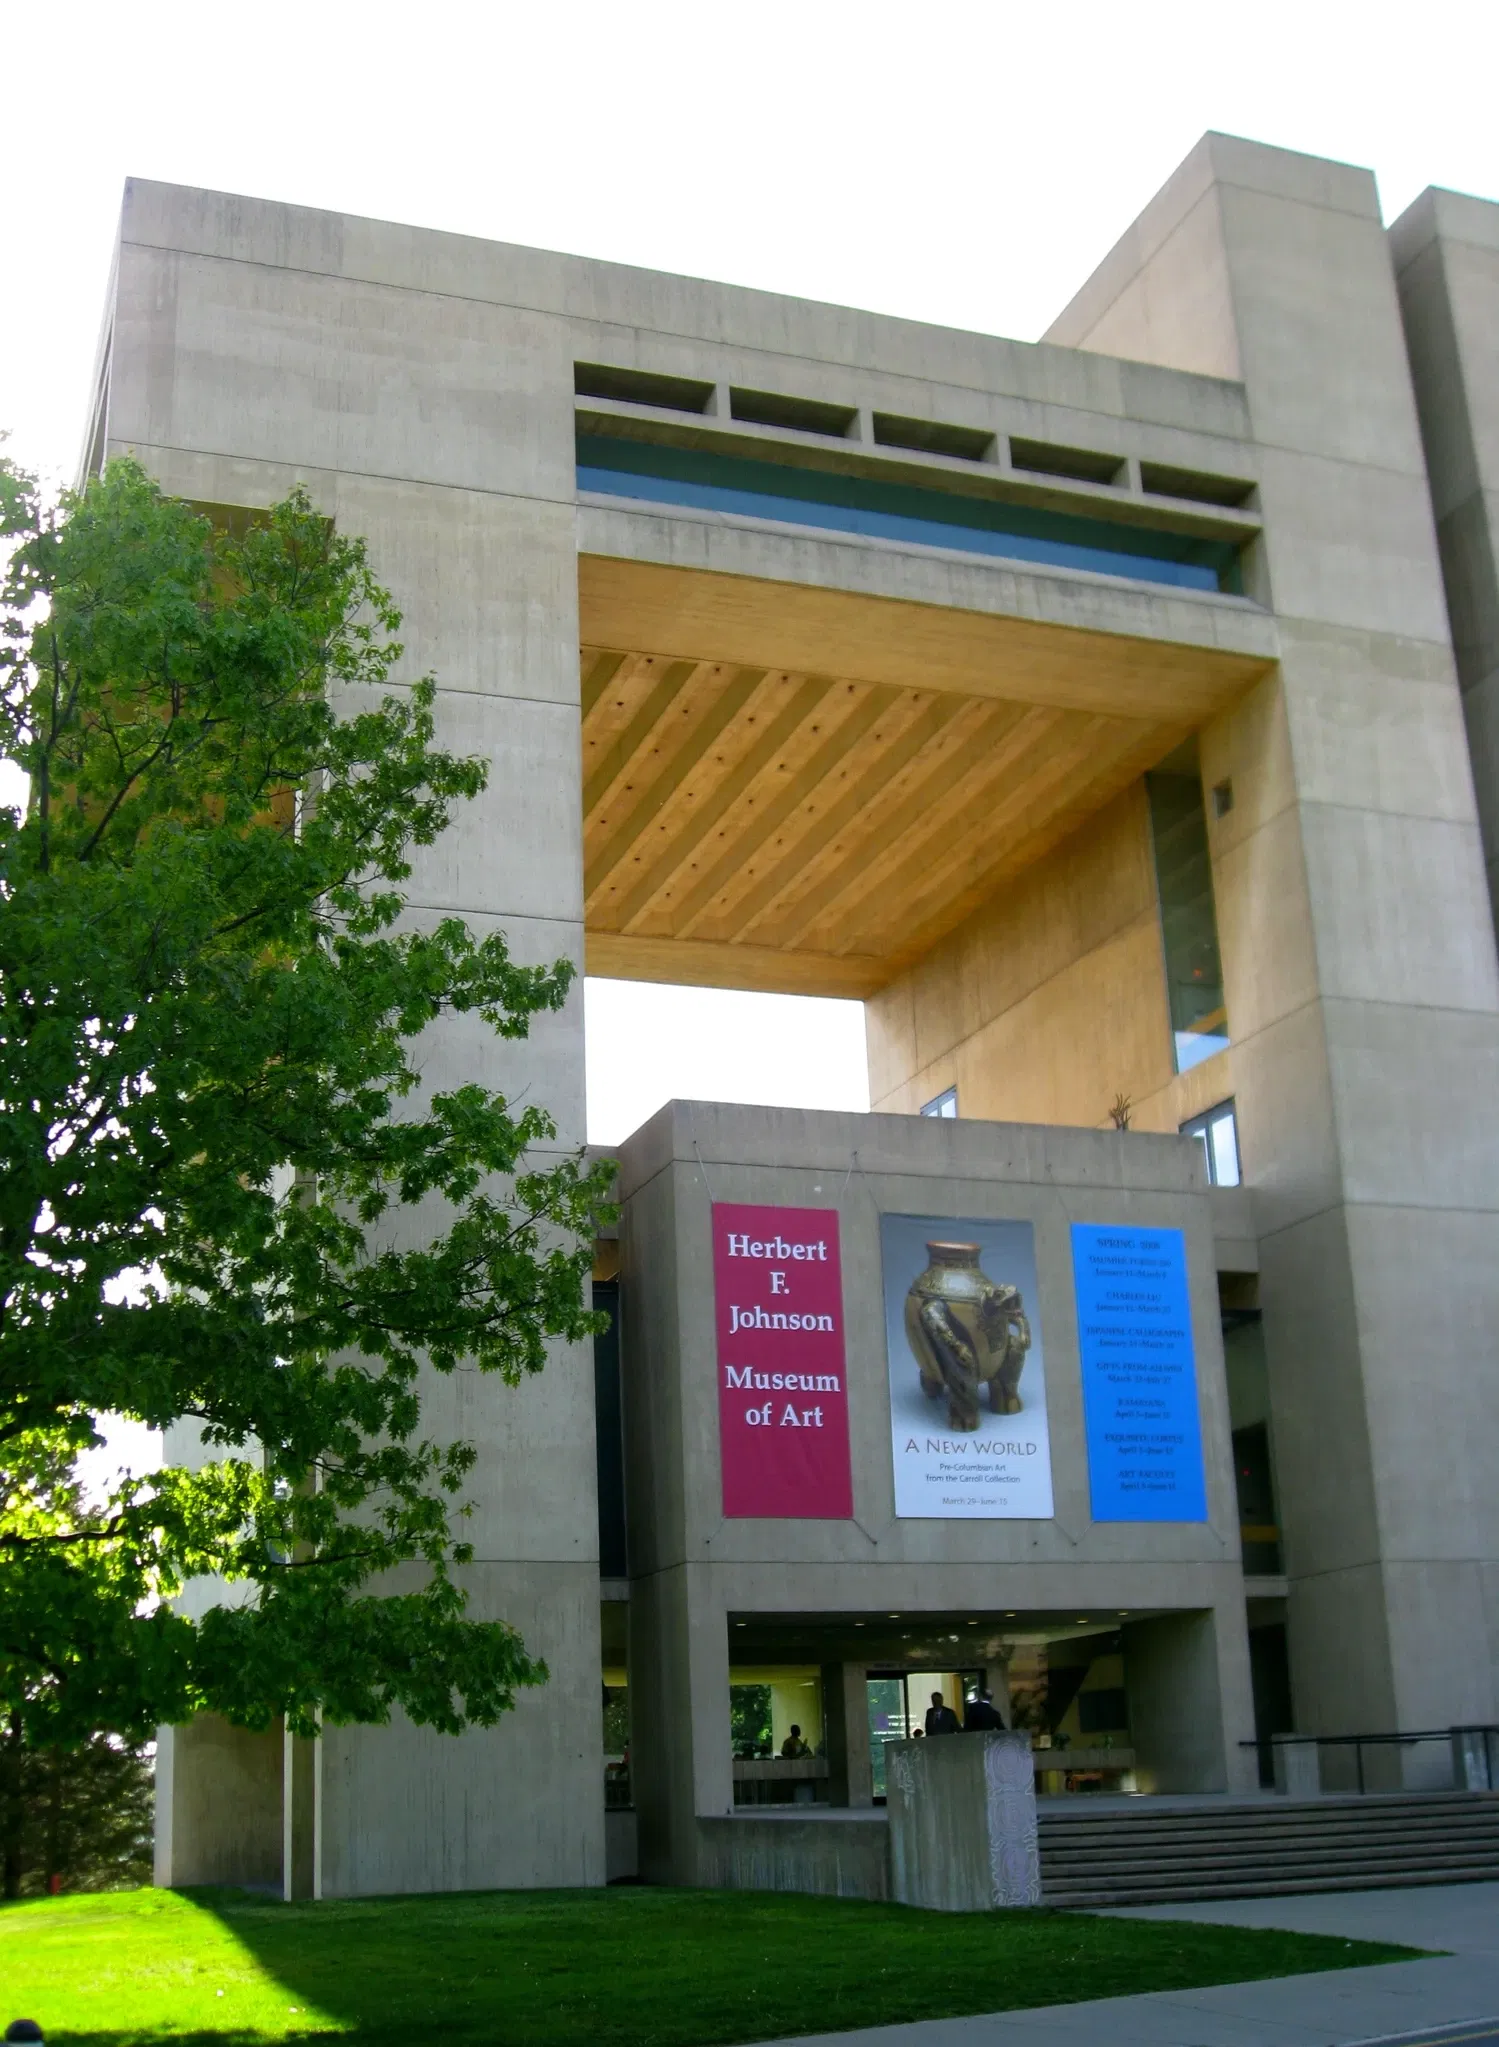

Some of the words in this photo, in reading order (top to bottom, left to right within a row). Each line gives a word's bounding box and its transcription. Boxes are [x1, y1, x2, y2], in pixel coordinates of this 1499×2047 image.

[727, 1234, 827, 1261] Herbert
[769, 1271, 790, 1295] F.
[729, 1305, 834, 1334] Johnson
[725, 1365, 841, 1392] Museum
[744, 1403, 773, 1426] of
[780, 1404, 824, 1428] Art
[905, 1438, 920, 1454] A
[926, 1439, 968, 1455] NEW
[973, 1440, 1037, 1456] WORLD
[939, 1463, 993, 1472] Pre-Columbian
[994, 1464, 1006, 1472] Art
[945, 1475, 958, 1483] the
[959, 1475, 983, 1483] Carroll
[984, 1475, 1021, 1483] Collection
[942, 1497, 966, 1505] March
